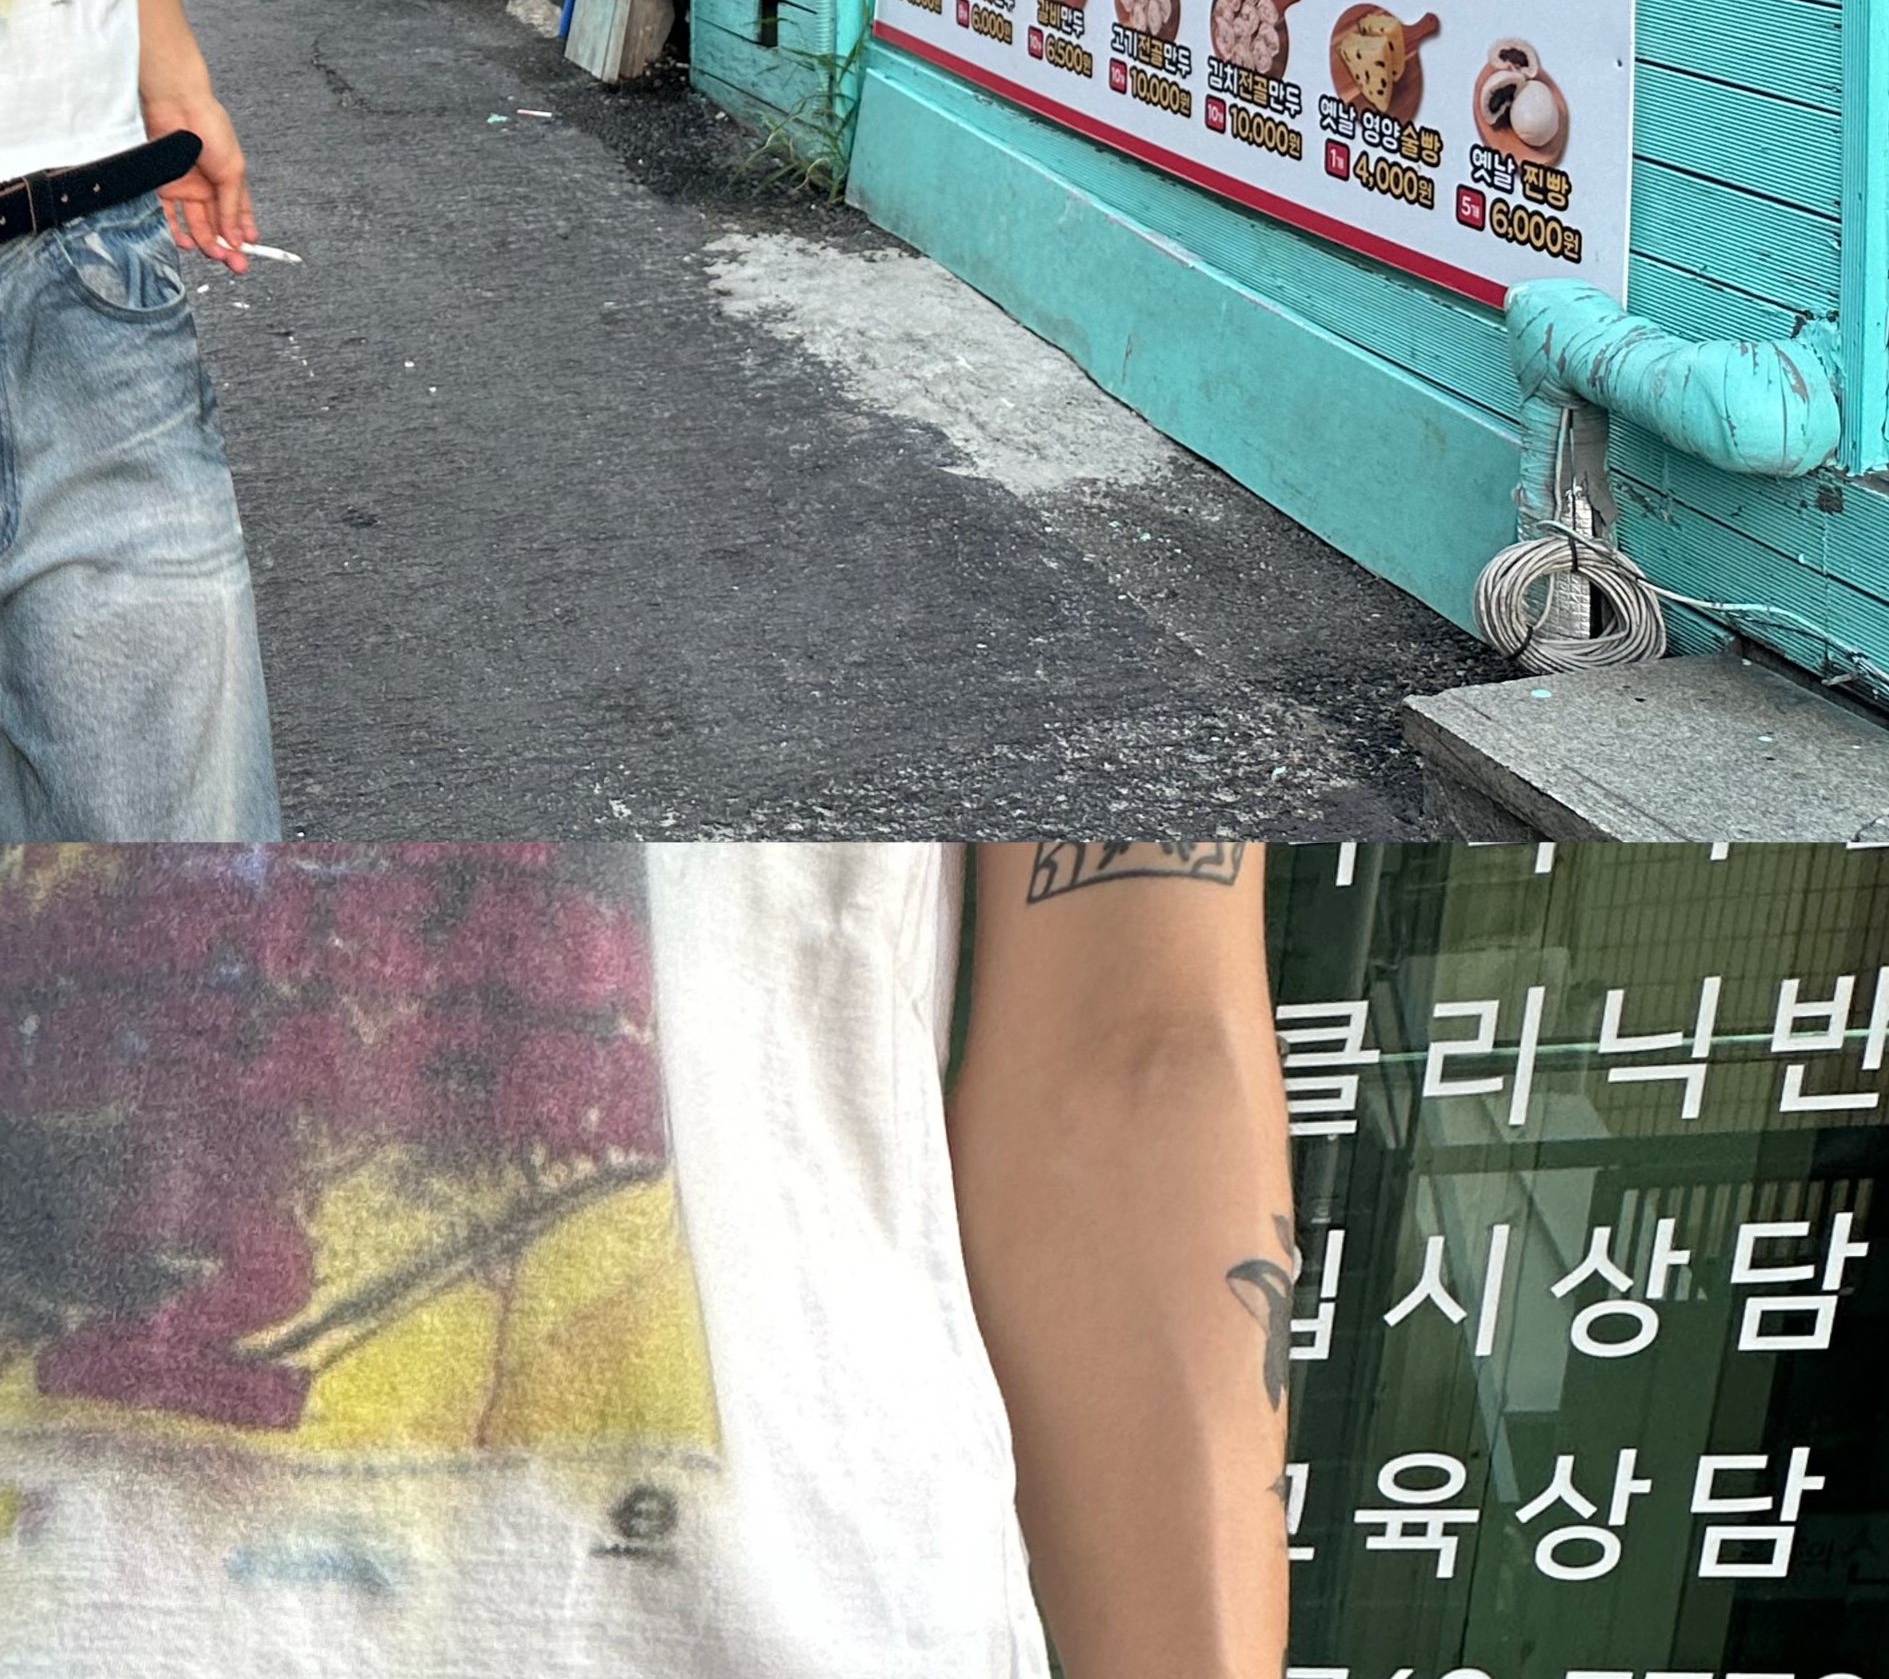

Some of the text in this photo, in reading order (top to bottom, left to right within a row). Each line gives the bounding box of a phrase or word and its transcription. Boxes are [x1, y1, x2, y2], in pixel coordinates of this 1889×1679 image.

[972, 5, 1013, 44] 6,000원
[1111, 24, 1192, 77] 고기전골만두
[1046, 36, 1093, 77] 6,500원
[1130, 67, 1192, 117] 10,000원
[1208, 57, 1302, 117] 김치전골만두
[1230, 105, 1302, 159] 10,000원
[1318, 96, 1443, 166] 옛날 영양술빵
[1354, 152, 1434, 208] 4,000원
[1471, 146, 1572, 209] 옛날 찐빵
[1491, 200, 1581, 261] 6,000원
